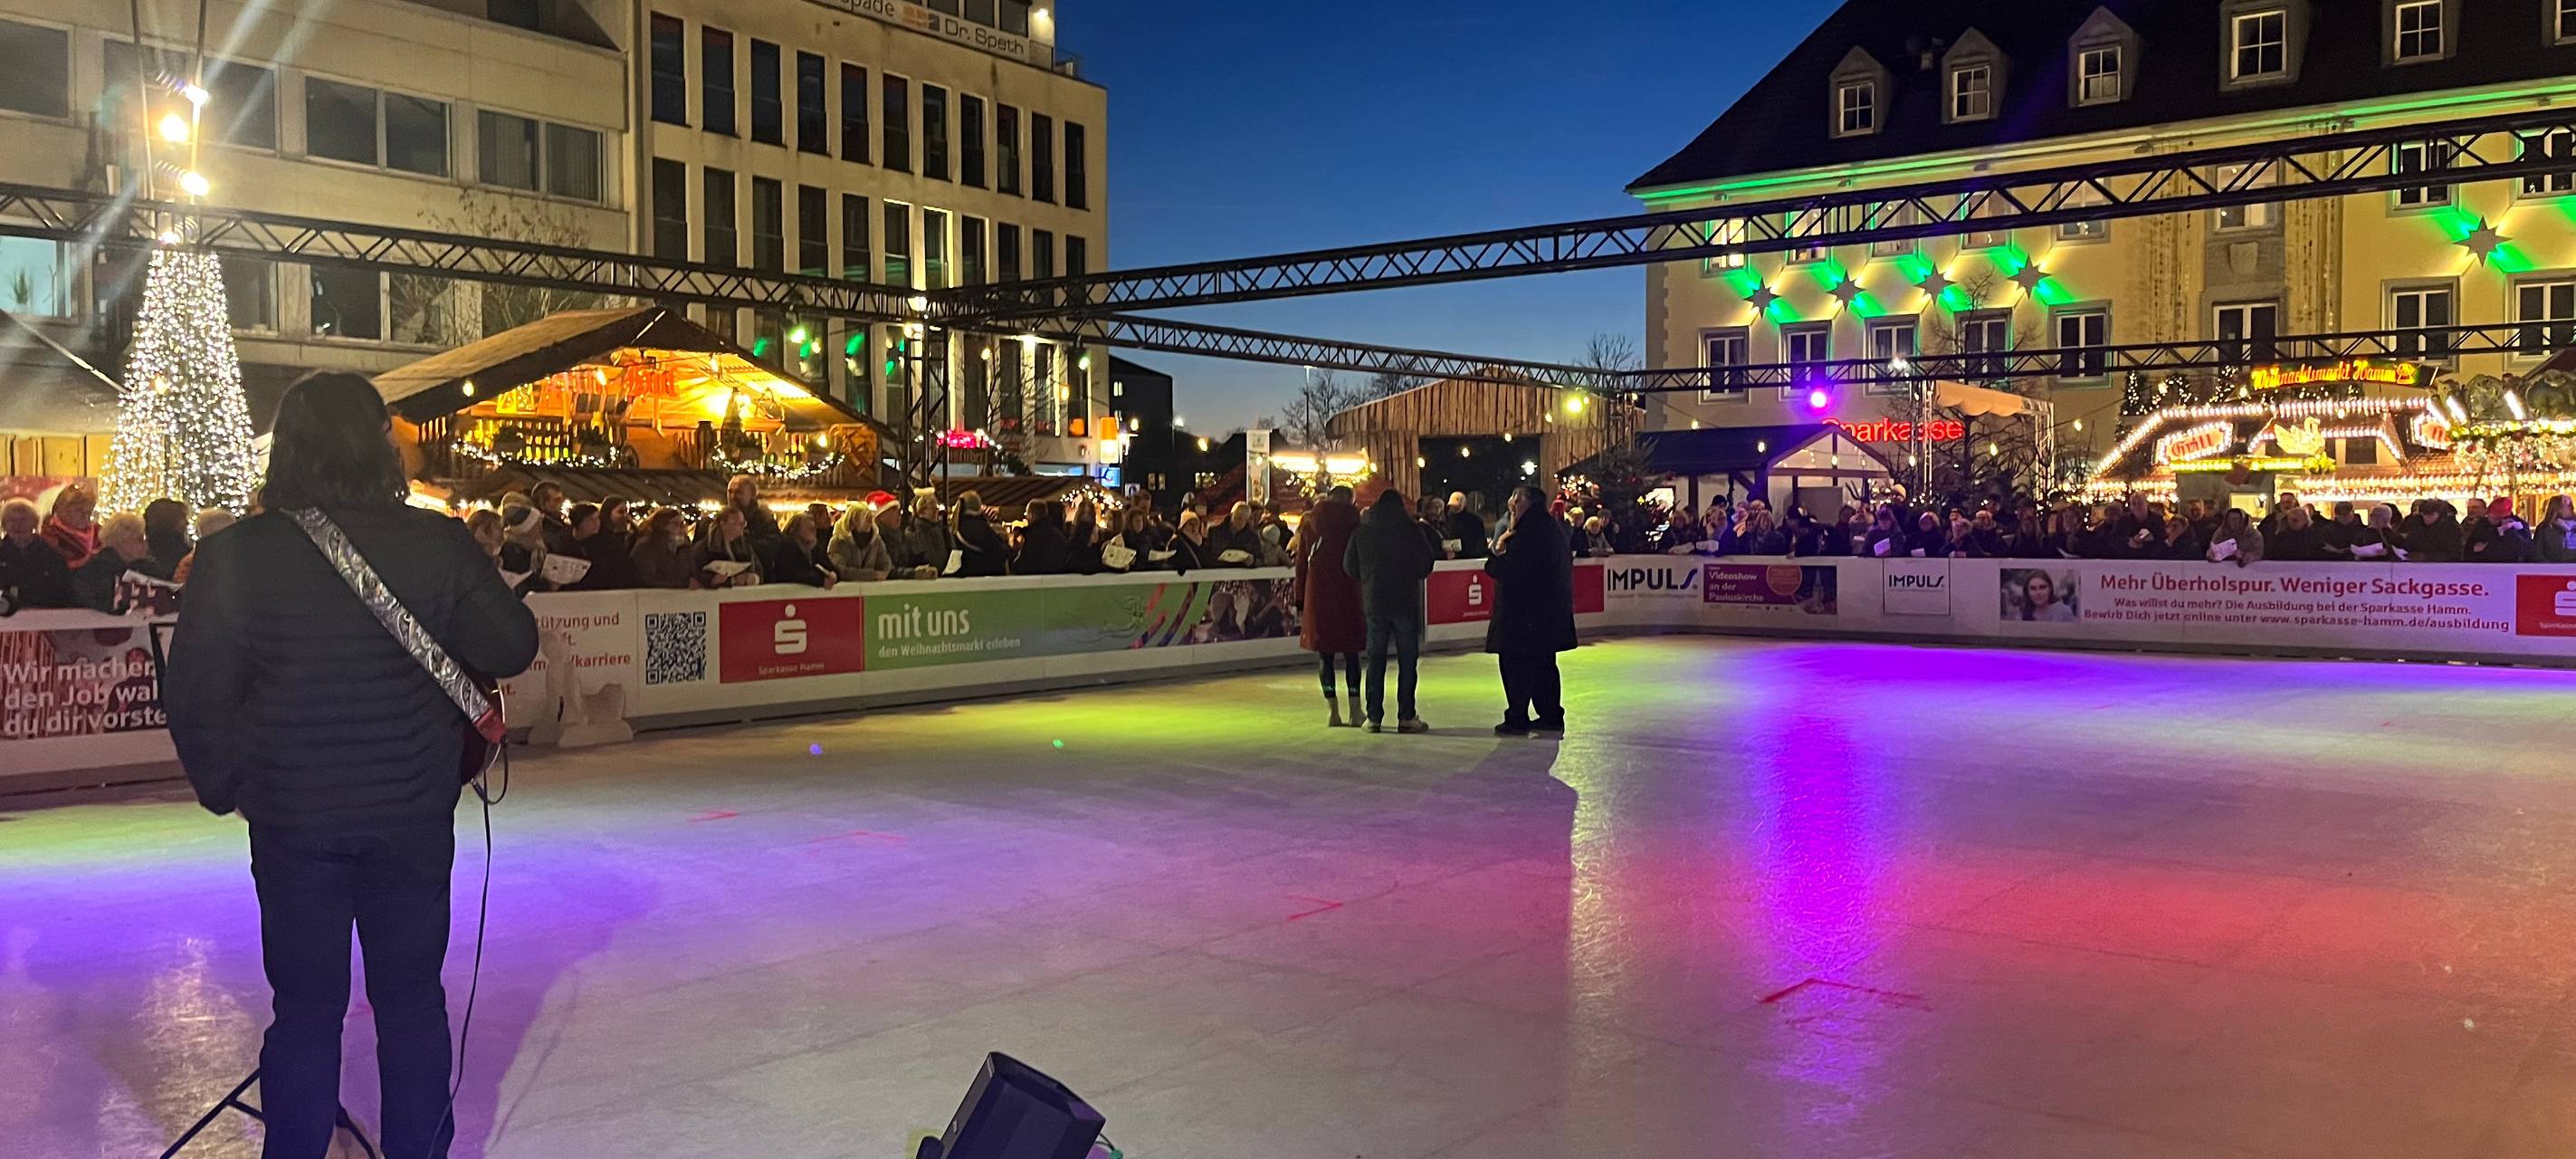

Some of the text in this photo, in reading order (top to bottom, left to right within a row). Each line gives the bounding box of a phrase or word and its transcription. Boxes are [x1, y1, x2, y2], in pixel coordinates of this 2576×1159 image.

[841, 0, 894, 16] pade
[945, 18, 1024, 54] Dr. Speth
[2353, 359, 2396, 382] Hamm
[1822, 417, 1964, 442] arkasse
[2171, 433, 2214, 456] Grill
[1722, 582, 1736, 591] der
[2101, 572, 2489, 599] Mehr Überholspur. Weniger Sackgasse.
[2114, 598, 2473, 616] Was willst du mehr? Die Ausbildung bei der Sparkasse Hamm.
[594, 612, 619, 626] und
[878, 603, 970, 639] mit uns
[2085, 609, 2509, 632] Bewirb Dich jetzt online unter www.sparkasse-hamm.de/ausbildung
[879, 637, 1021, 657] den Weihnachtsmarkt erleben
[4, 661, 52, 684] Wir
[5, 688, 53, 710] den
[62, 683, 109, 706] Job
[4, 712, 38, 736] du
[47, 709, 83, 733] dir
